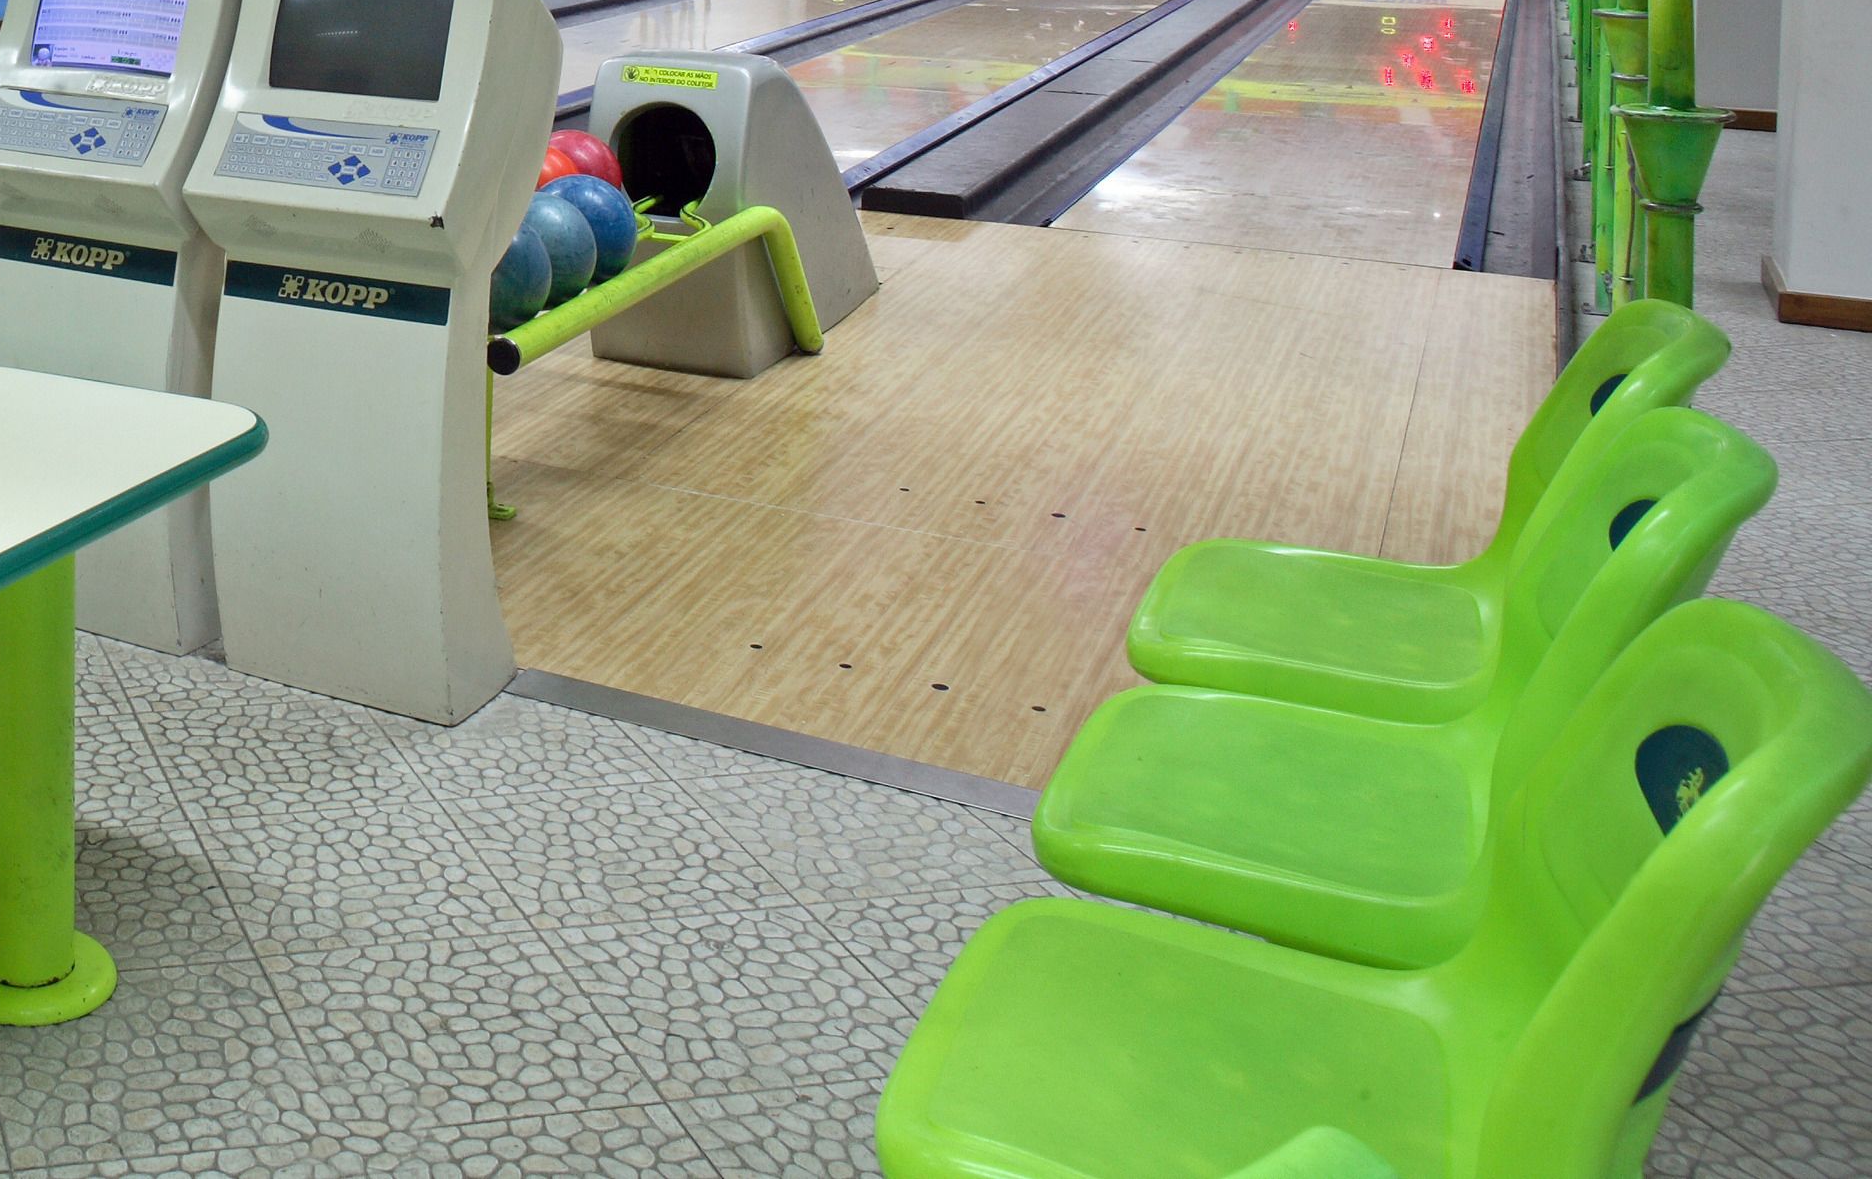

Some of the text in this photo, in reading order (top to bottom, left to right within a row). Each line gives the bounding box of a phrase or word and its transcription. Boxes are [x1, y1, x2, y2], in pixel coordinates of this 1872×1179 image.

[402, 134, 429, 142] KOPP
[52, 241, 125, 271] KOPP
[302, 278, 389, 310] KOPP
